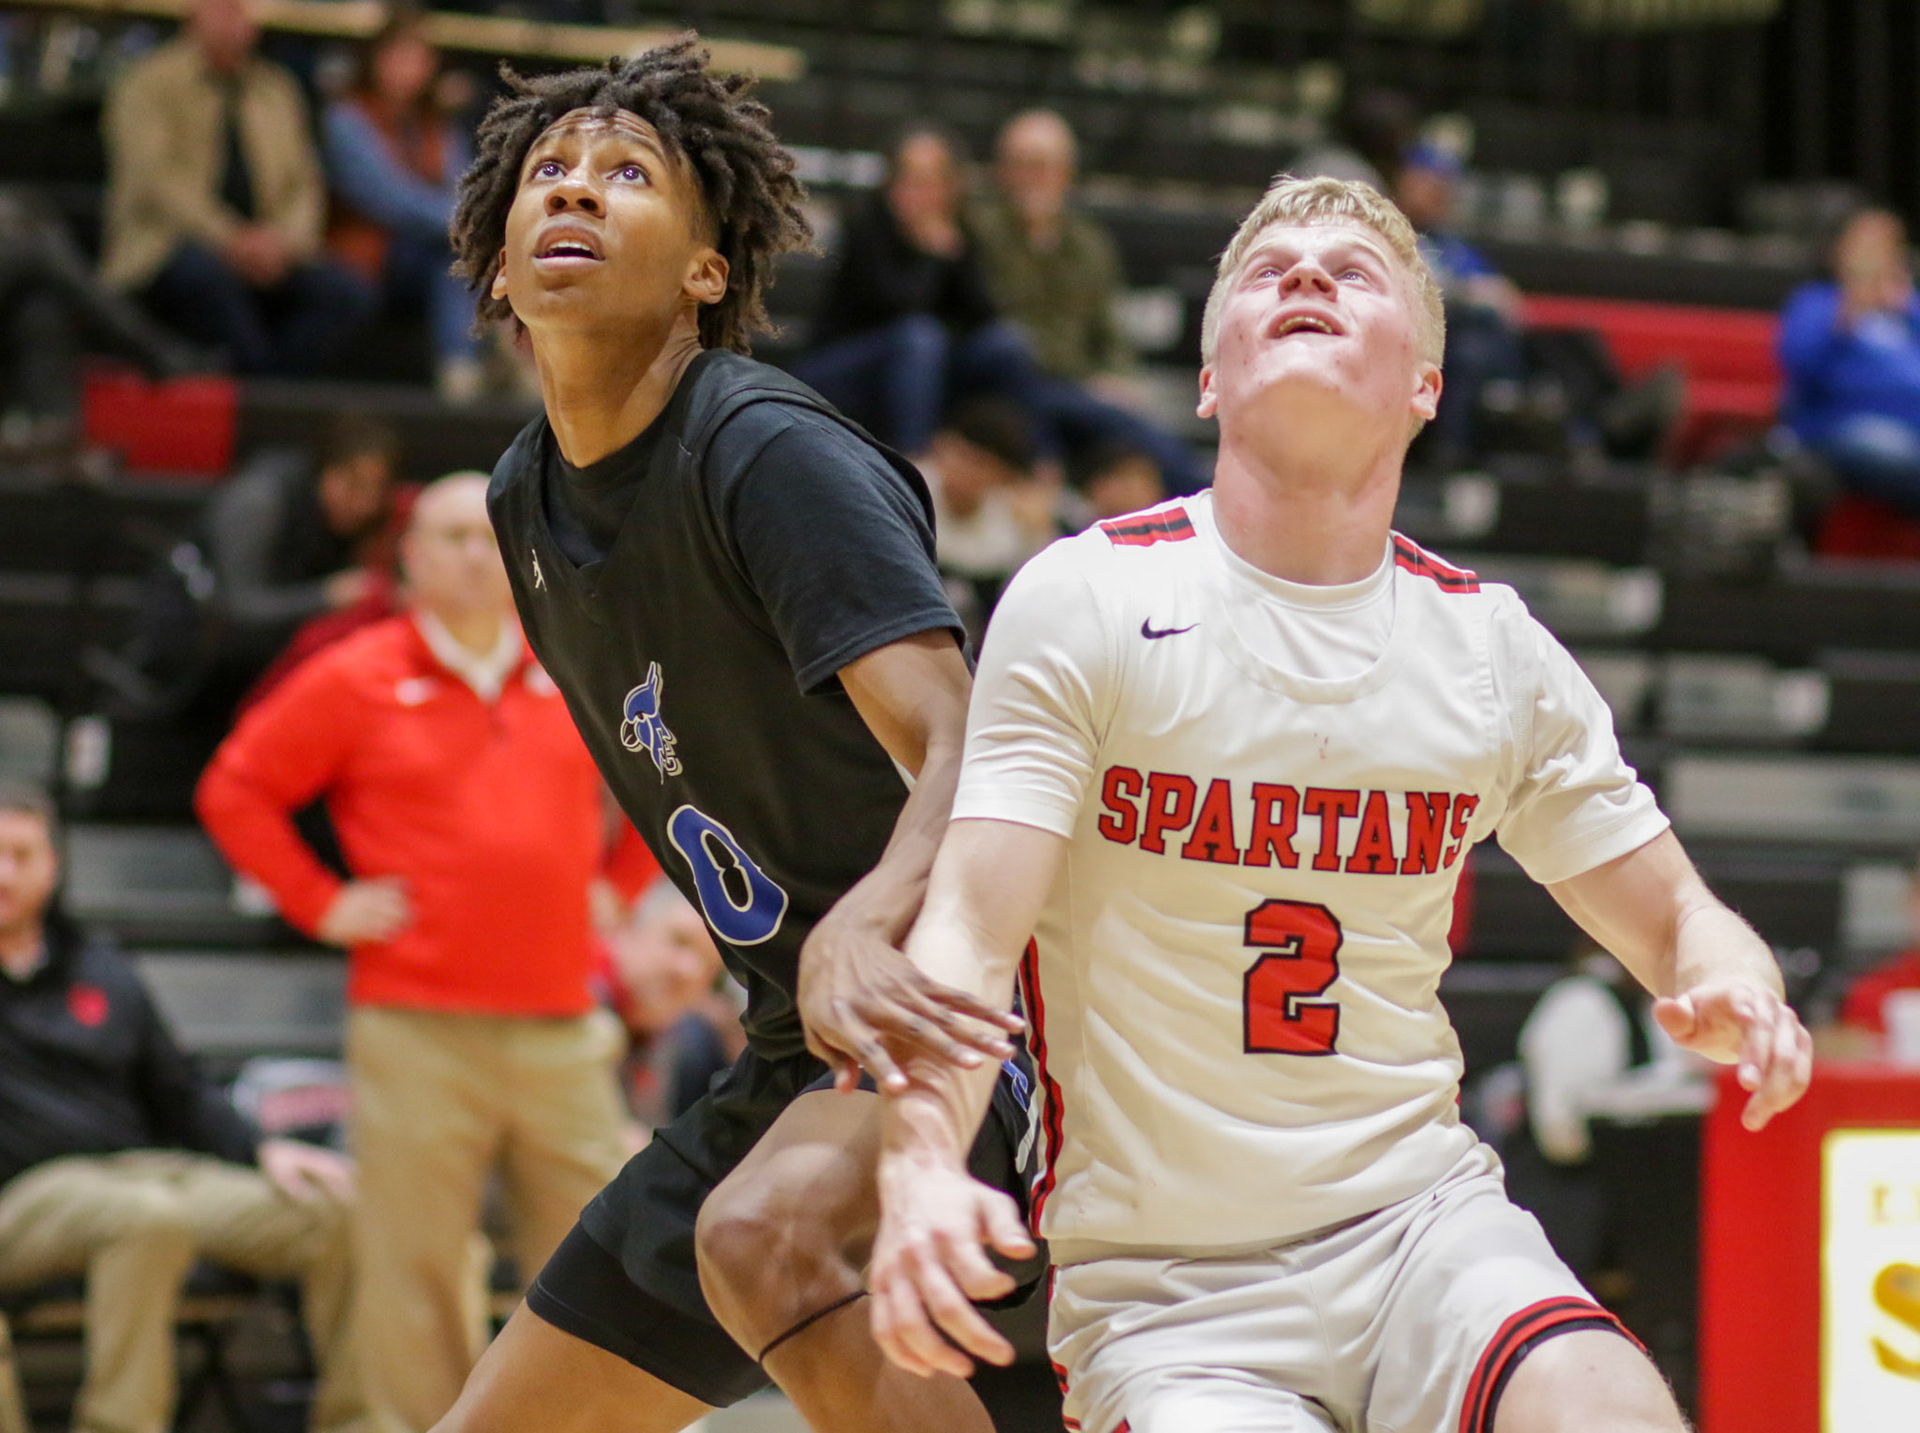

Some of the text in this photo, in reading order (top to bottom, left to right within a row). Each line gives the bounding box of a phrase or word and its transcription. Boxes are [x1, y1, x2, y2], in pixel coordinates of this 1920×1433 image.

[666, 803, 789, 946] 0
[1098, 765, 1480, 875] SPARTANS
[1243, 898, 1344, 1057] 2
